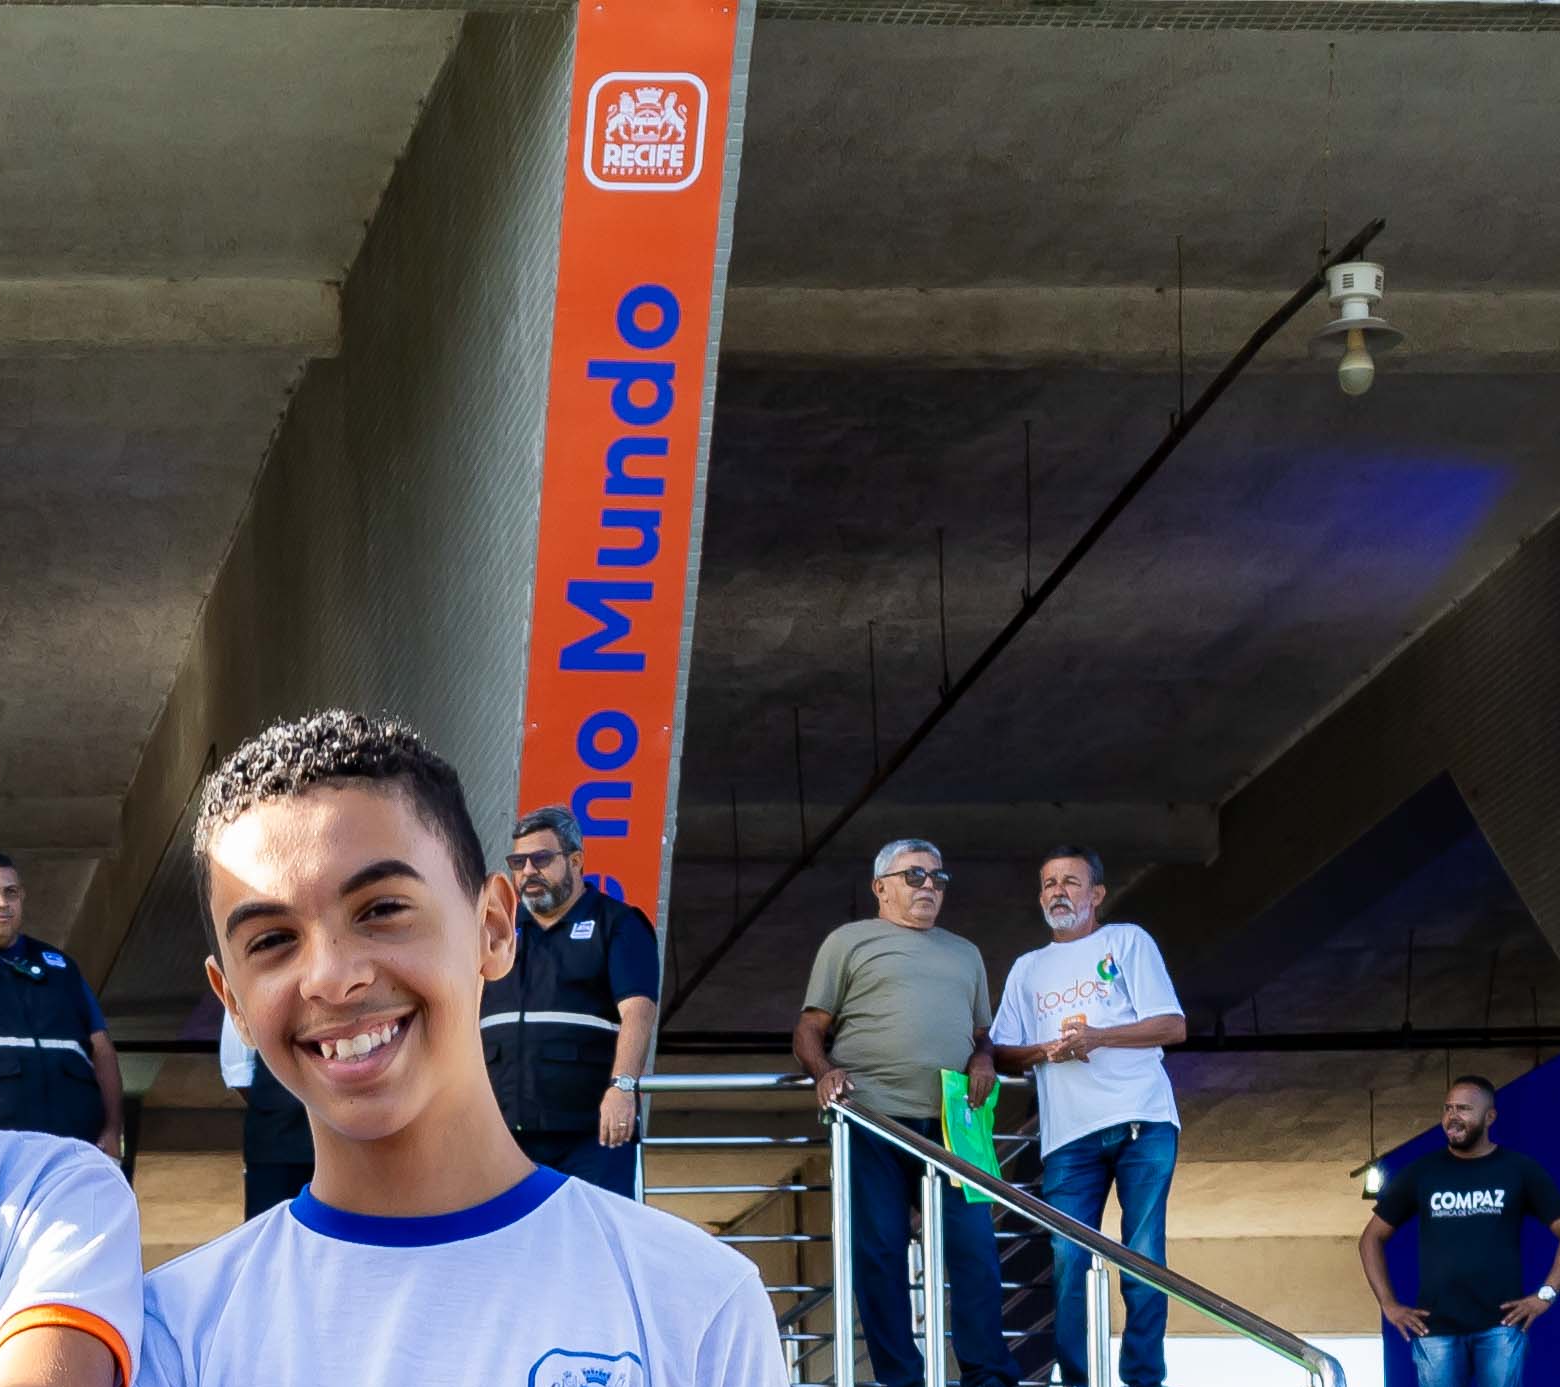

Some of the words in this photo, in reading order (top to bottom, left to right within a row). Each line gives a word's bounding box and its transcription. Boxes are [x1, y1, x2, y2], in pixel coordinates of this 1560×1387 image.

[603, 143, 685, 167] RECIFE
[602, 167, 683, 176] PREFEITURA
[558, 283, 681, 673] Mundo
[570, 709, 639, 839] no
[1430, 1189, 1505, 1211] COMPAZ
